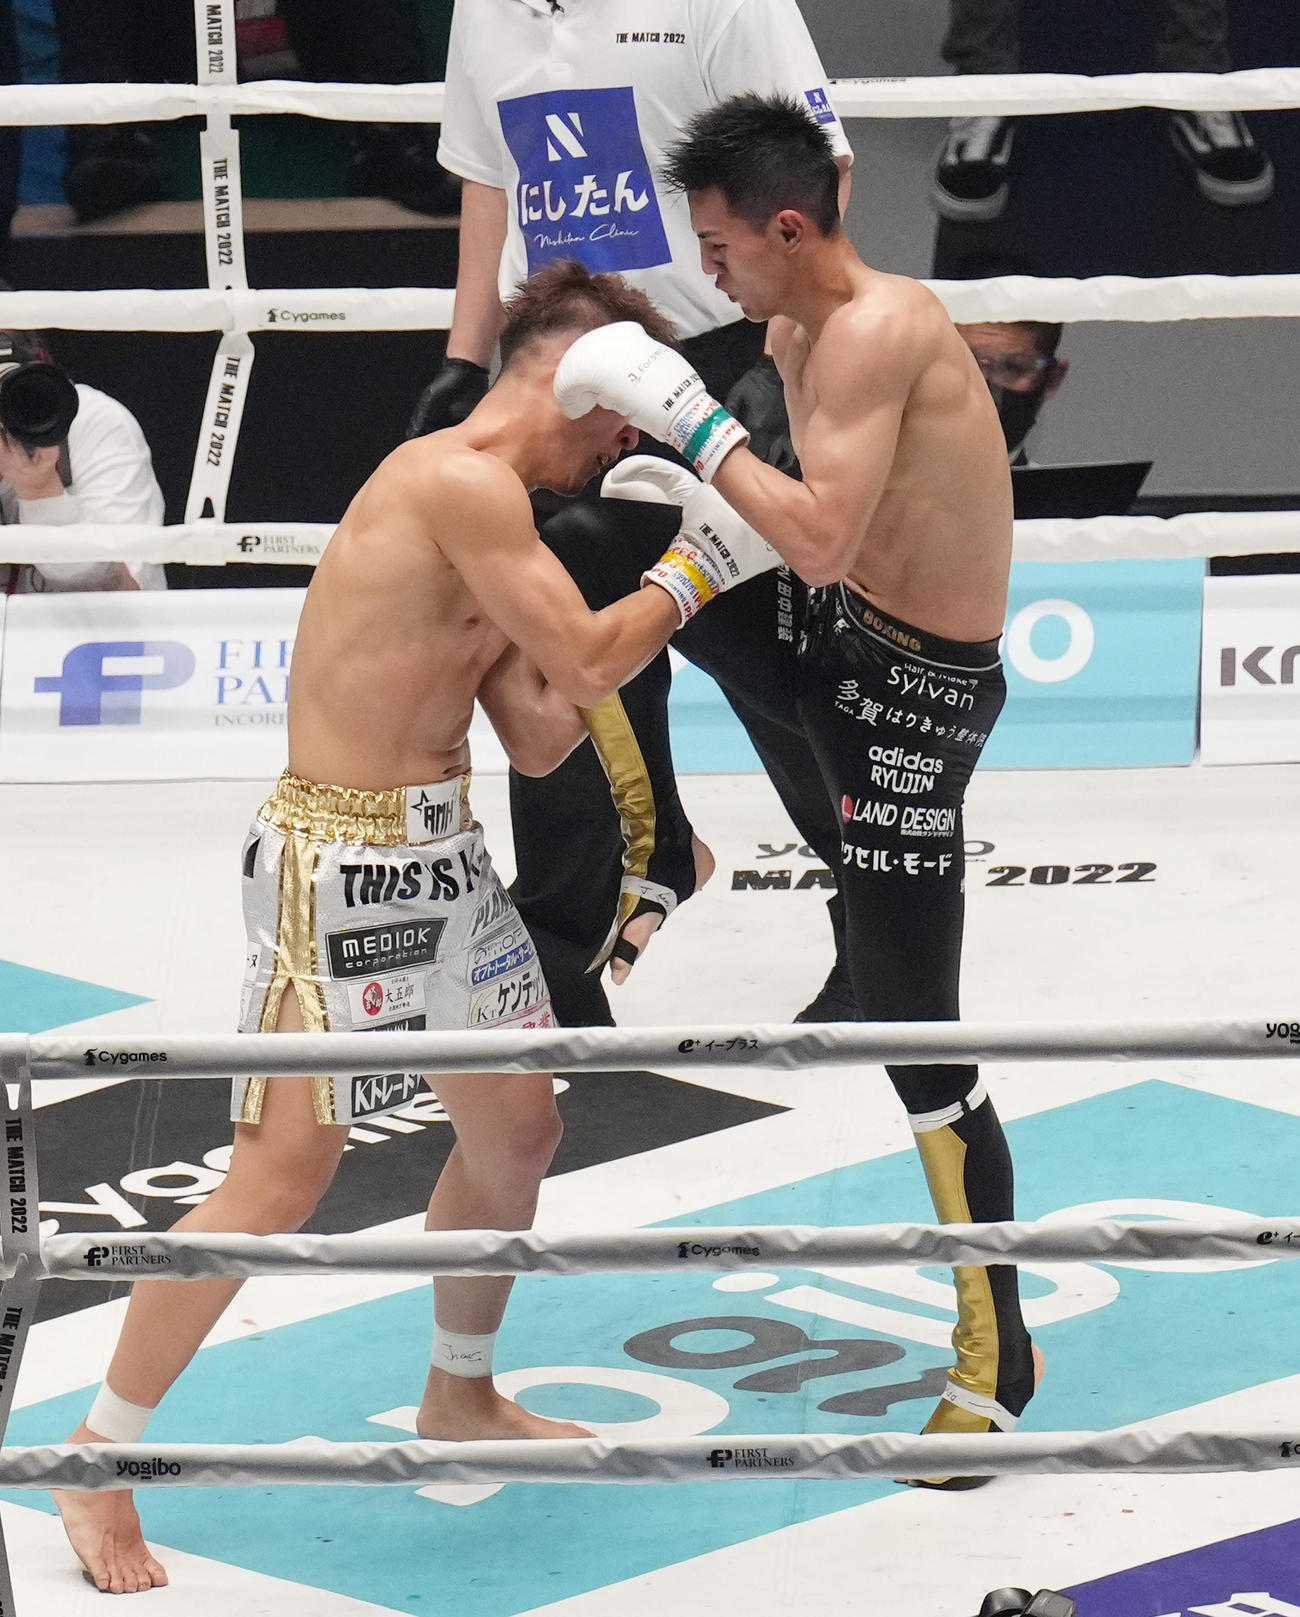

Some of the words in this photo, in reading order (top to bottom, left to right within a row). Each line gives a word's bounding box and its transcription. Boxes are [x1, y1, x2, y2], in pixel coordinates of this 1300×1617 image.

[206, 4, 223, 48] MATCH
[616, 32, 629, 43] THE
[632, 32, 660, 43] MATCH
[663, 32, 685, 44] 2022
[209, 49, 224, 74] 2022
[213, 158, 228, 180] THE
[215, 184, 231, 228] MATCH
[521, 170, 649, 226] にしたん
[217, 232, 233, 266] 2022
[280, 310, 346, 323] Cygames
[223, 356, 241, 379] THE
[214, 383, 235, 429] MATCH
[206, 432, 224, 467] 2022
[699, 523, 713, 536] THE
[709, 534, 732, 559] MATCH
[726, 559, 740, 578] 2022
[863, 610, 922, 652] BOXING
[887, 666, 975, 711] Sylvan
[834, 701, 854, 715] TAGA
[868, 746, 944, 774] adidas
[871, 765, 935, 794] RYUJIN
[852, 798, 898, 826] LAND
[900, 806, 956, 831] DESIGN
[841, 841, 953, 876] クセル・モード
[340, 861, 422, 908] THIS
[425, 858, 459, 901] IS
[985, 861, 1158, 886] 2022
[342, 927, 431, 958] MEDIOK
[345, 948, 427, 969] corporation
[98, 1050, 167, 1064] Cygames
[705, 1037, 758, 1052] イープラス
[5, 1118, 22, 1142] THE
[7, 1145, 27, 1193] MATCH
[10, 1197, 28, 1234] 2022
[111, 1245, 146, 1256] FIRST
[111, 1254, 172, 1266] PARTNERS
[691, 1243, 760, 1259] Cygames
[3, 1307, 23, 1330] THE
[734, 1448, 769, 1459] FIRST
[734, 1457, 795, 1468] PARTNERS
[116, 1458, 181, 1480] yogibo
